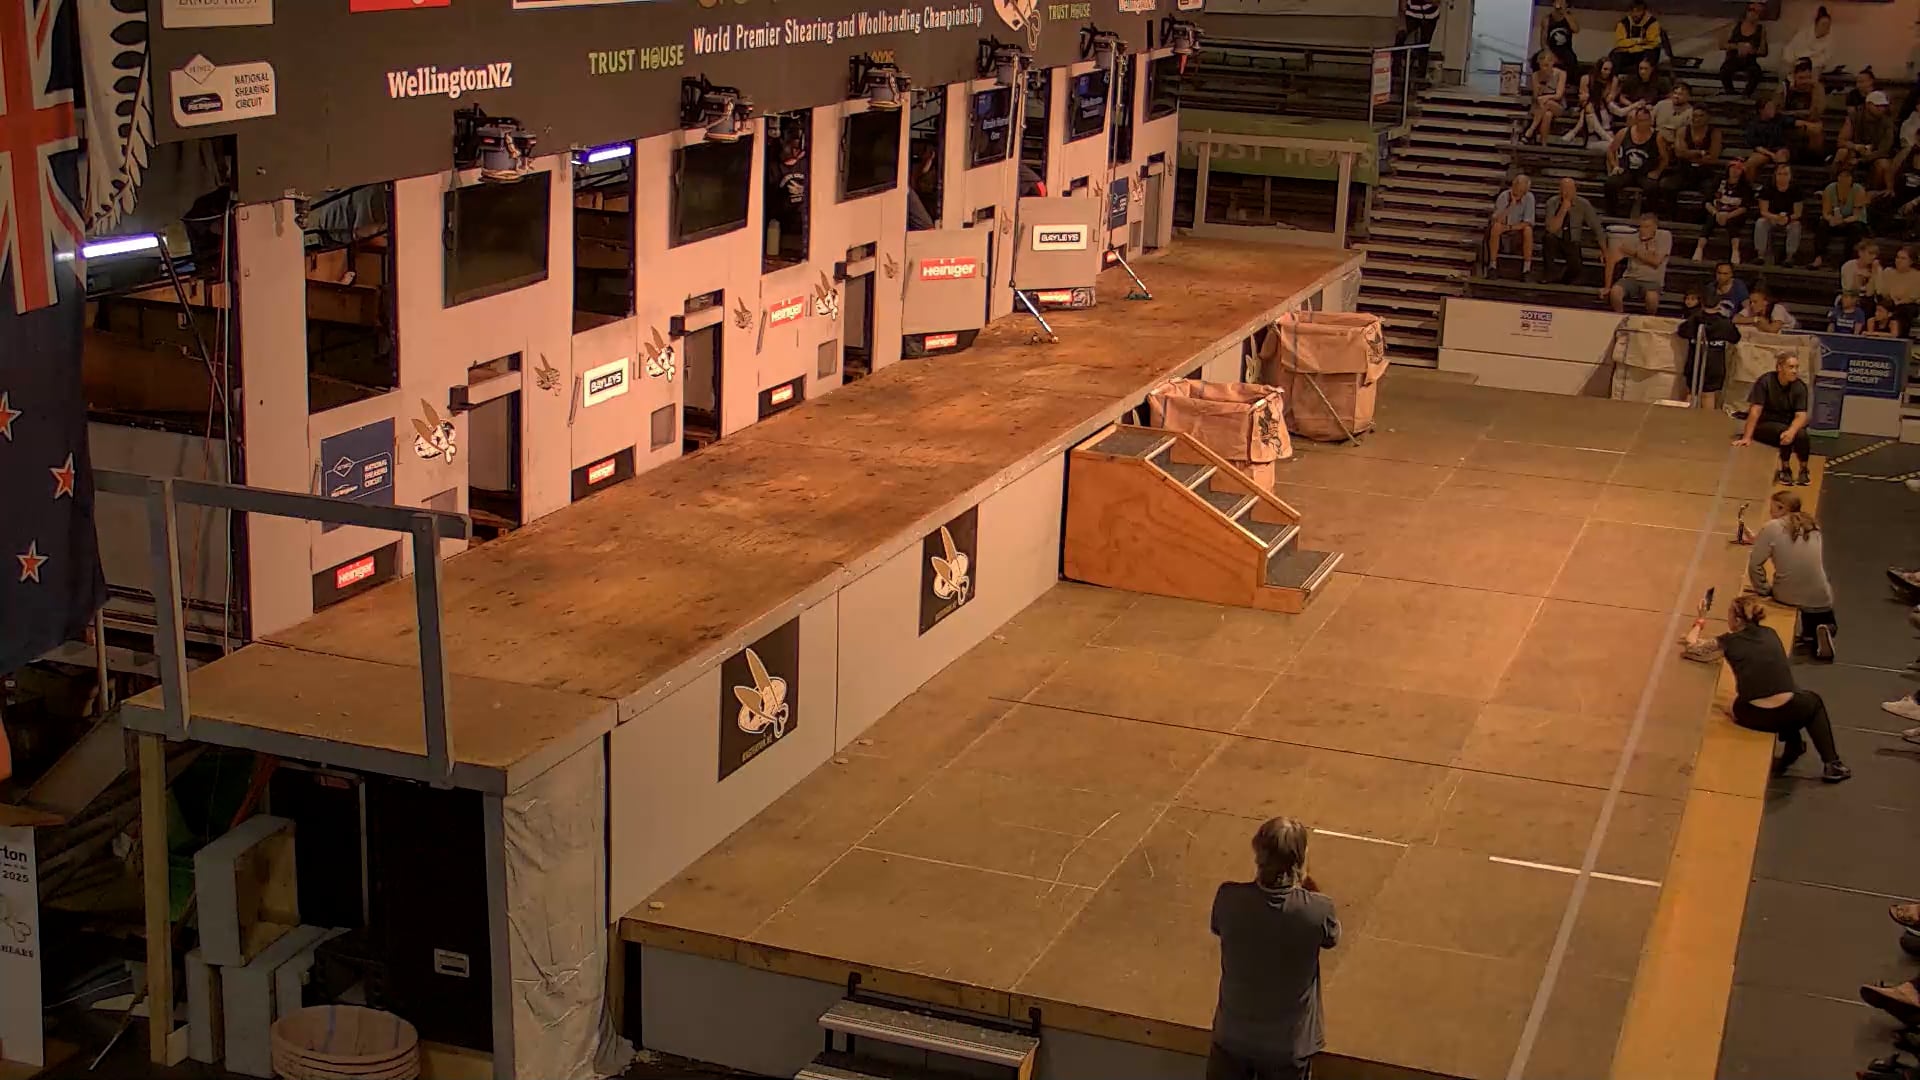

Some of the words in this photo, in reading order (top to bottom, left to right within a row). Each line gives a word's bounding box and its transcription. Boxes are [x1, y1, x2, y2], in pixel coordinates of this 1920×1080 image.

[694, 26, 730, 54] World
[736, 22, 781, 50] Premier
[785, 17, 834, 45] Shearing
[837, 13, 855, 39] and
[858, 9, 921, 36] Woolhandling
[924, 2, 982, 31] Championship
[588, 49, 636, 75] TRUST
[640, 44, 684, 71] HOUSE
[234, 72, 270, 85] NATIONAL
[387, 62, 512, 99] WellingtonNZ
[235, 84, 270, 97] SHEARING
[235, 97, 263, 109] CIRCUIT
[1041, 233, 1080, 243] BAYLEYS
[922, 259, 976, 278] Heiniger
[1520, 310, 1552, 321] NOTICE
[591, 371, 623, 393] BAYLEYS
[2, 870, 29, 883] 2025
